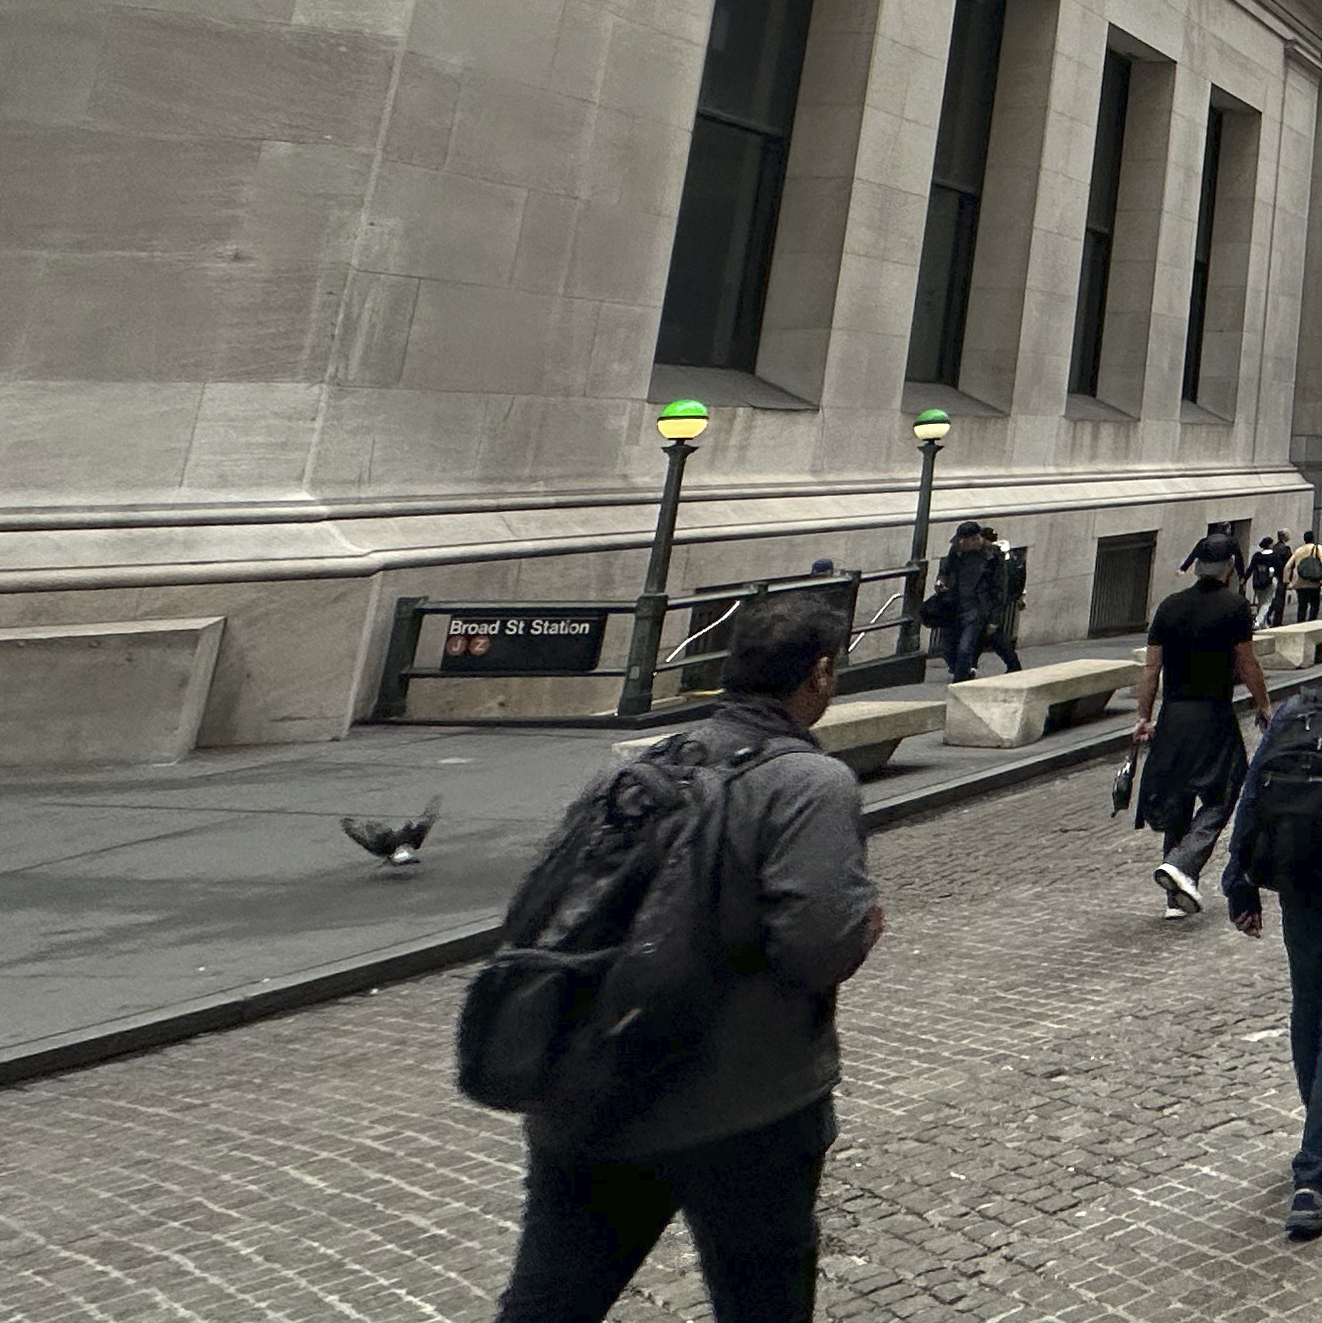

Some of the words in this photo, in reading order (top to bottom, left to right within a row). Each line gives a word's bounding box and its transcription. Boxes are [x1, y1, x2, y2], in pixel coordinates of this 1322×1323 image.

[449, 618, 500, 635] Broad
[504, 619, 525, 635] St
[530, 620, 590, 635] Station
